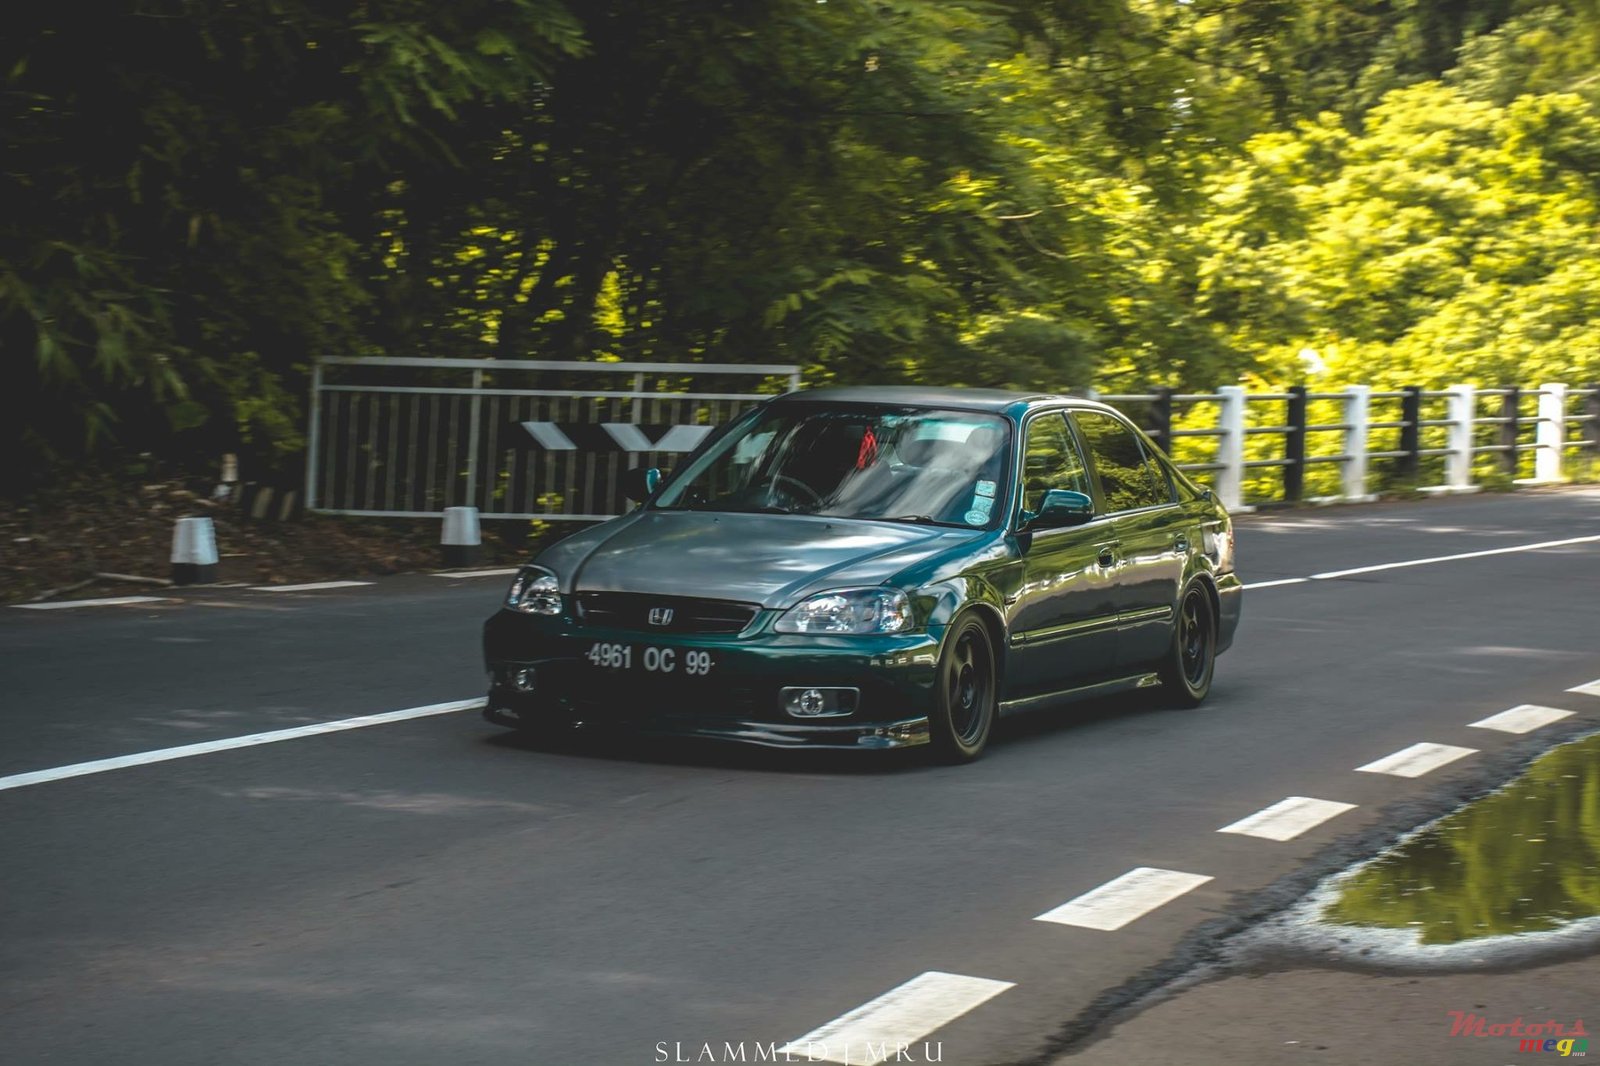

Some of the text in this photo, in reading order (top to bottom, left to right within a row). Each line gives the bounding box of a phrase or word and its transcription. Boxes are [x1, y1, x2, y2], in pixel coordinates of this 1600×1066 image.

[588, 643, 711, 675] 4961 OC 99
